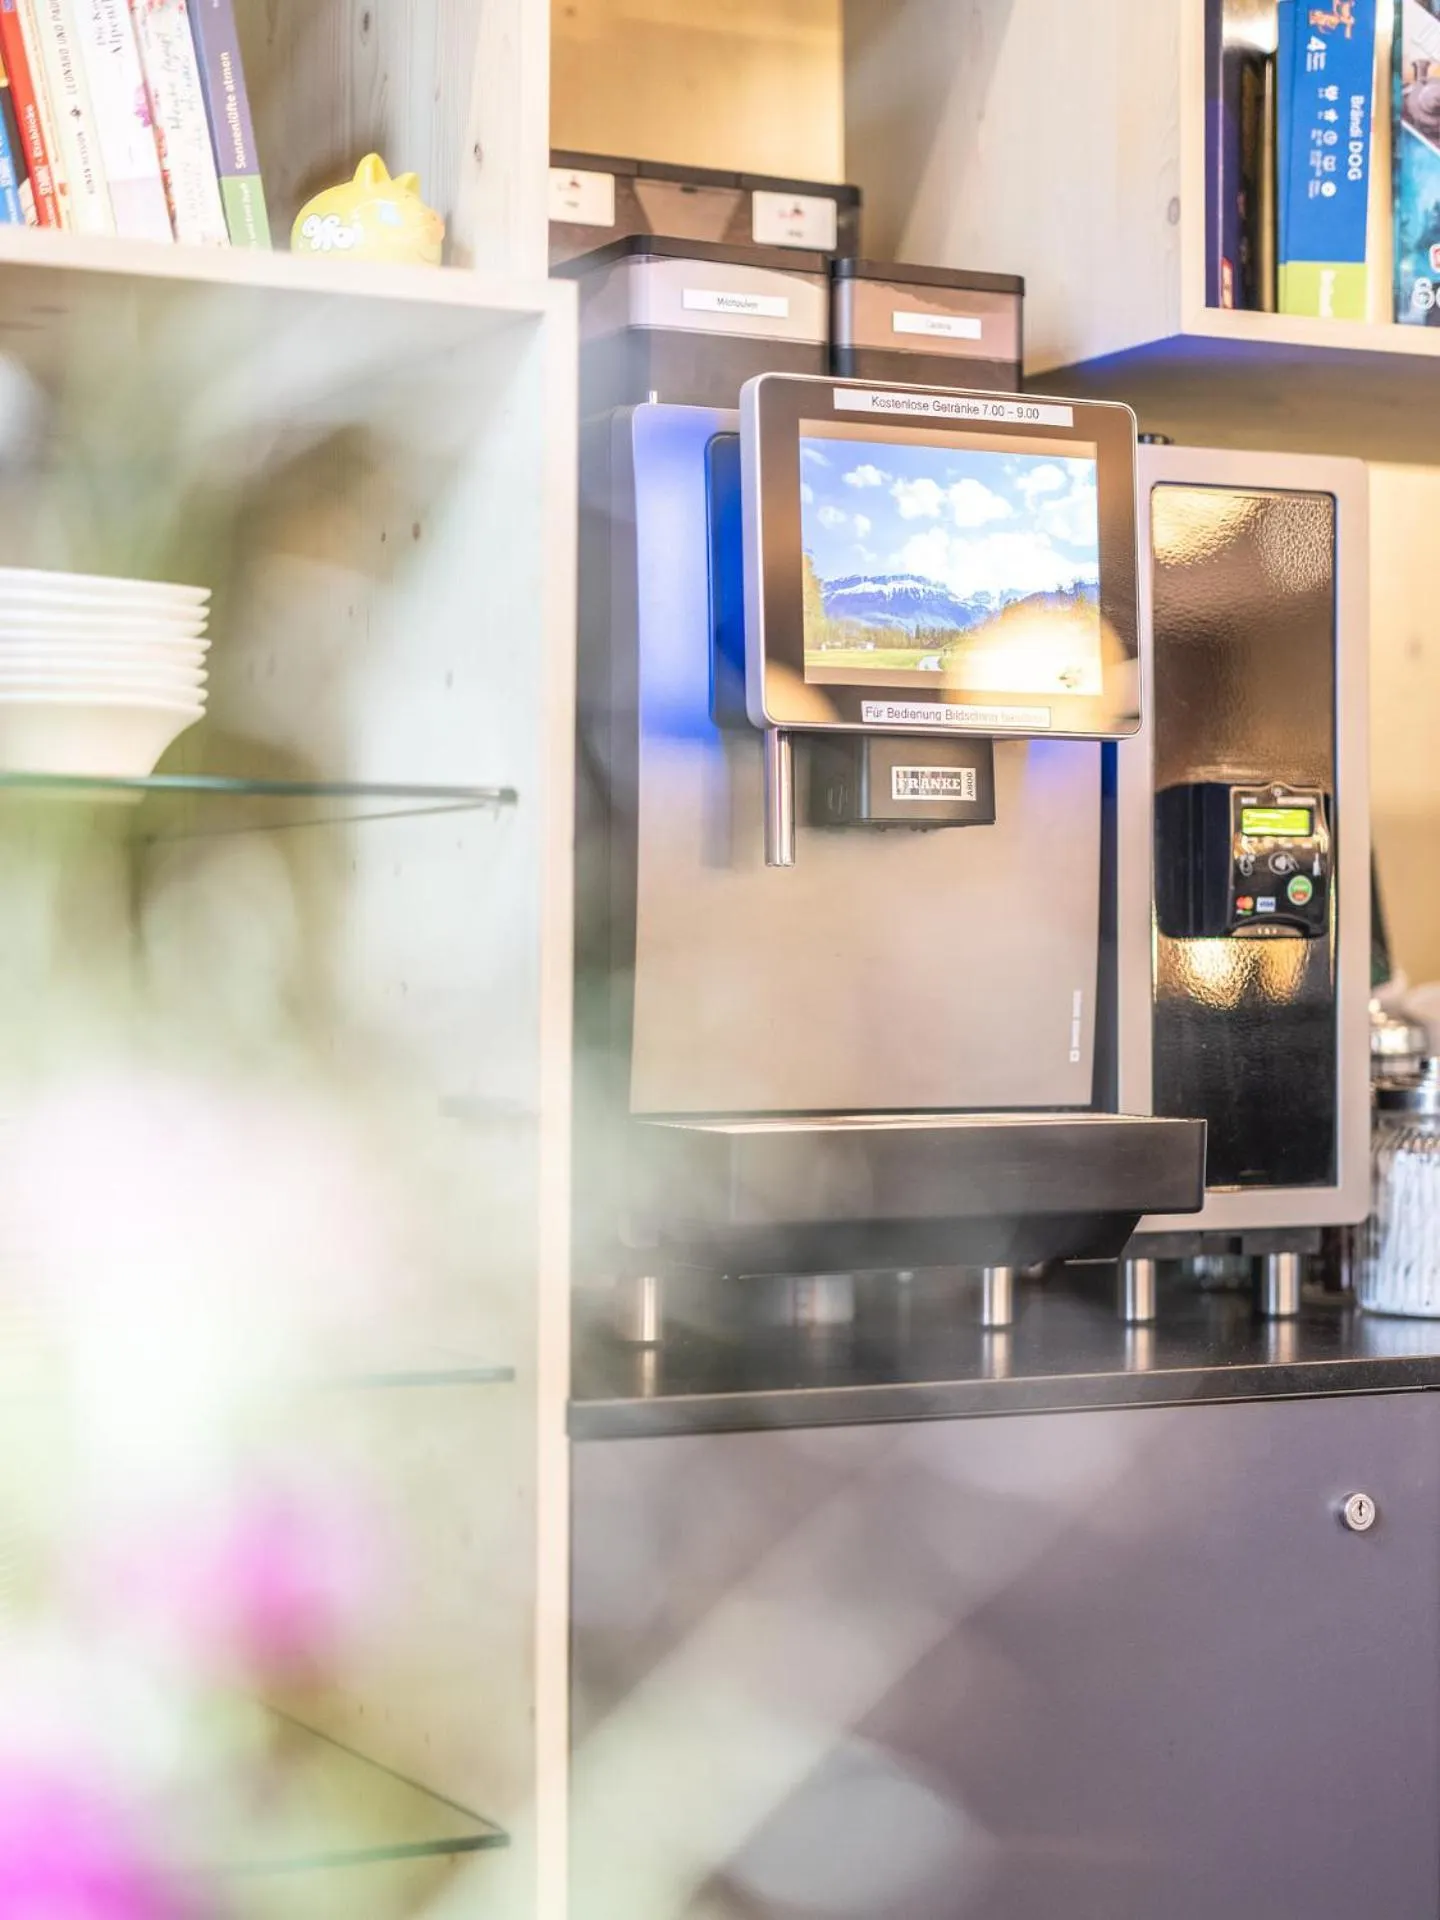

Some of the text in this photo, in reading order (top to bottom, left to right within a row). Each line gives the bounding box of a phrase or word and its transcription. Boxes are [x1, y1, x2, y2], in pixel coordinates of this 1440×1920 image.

[220, 51, 236, 92] atmen
[226, 93, 247, 169] Sonnenlüfte
[1347, 141, 1364, 181] DOG
[871, 395, 930, 411] Kostenlose
[932, 400, 980, 415] Getränke
[982, 403, 1005, 417] 7.00
[1017, 407, 1040, 420] 9.00
[865, 706, 883, 719] Für
[887, 707, 942, 721] Bedienung
[896, 777, 961, 790] FRANKE
